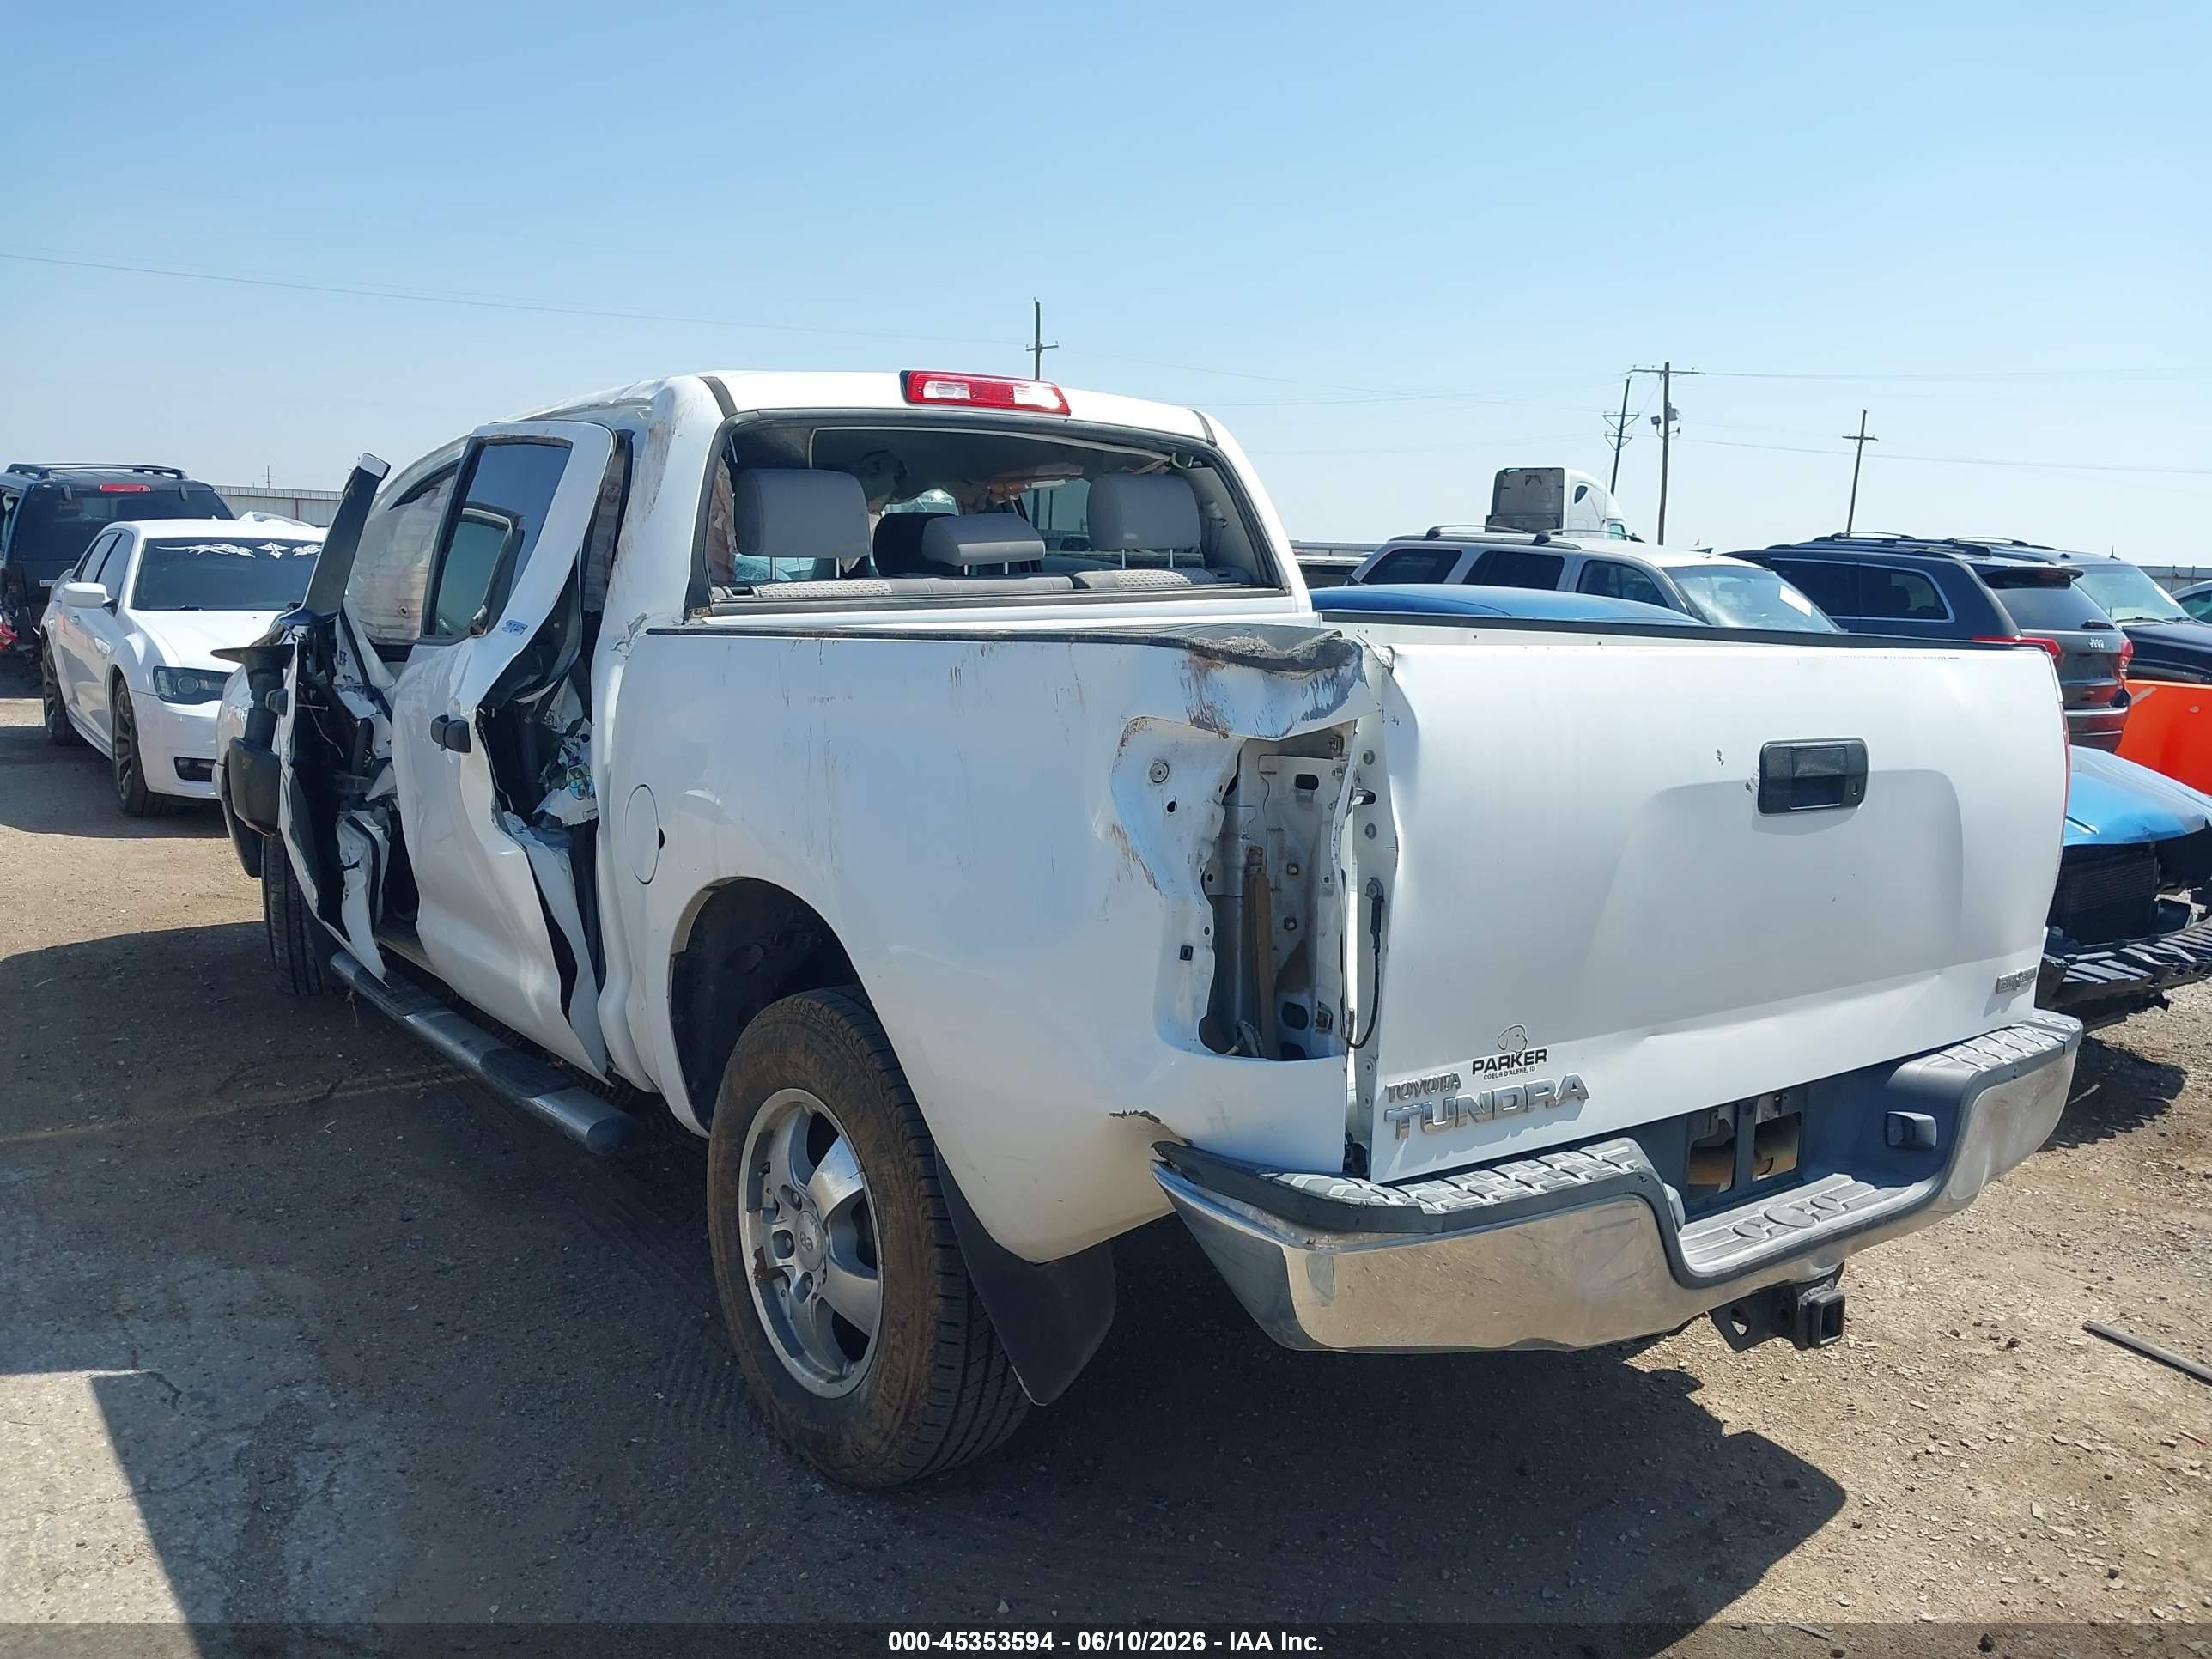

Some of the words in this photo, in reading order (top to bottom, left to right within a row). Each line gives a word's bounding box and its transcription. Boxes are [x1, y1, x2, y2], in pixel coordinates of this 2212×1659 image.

[1472, 1048, 1547, 1075] PARKER
[1483, 1071, 1504, 1080] COEUR
[1385, 1072, 1462, 1102] TOYOTA
[1384, 1073, 1590, 1140] TUNDRA
